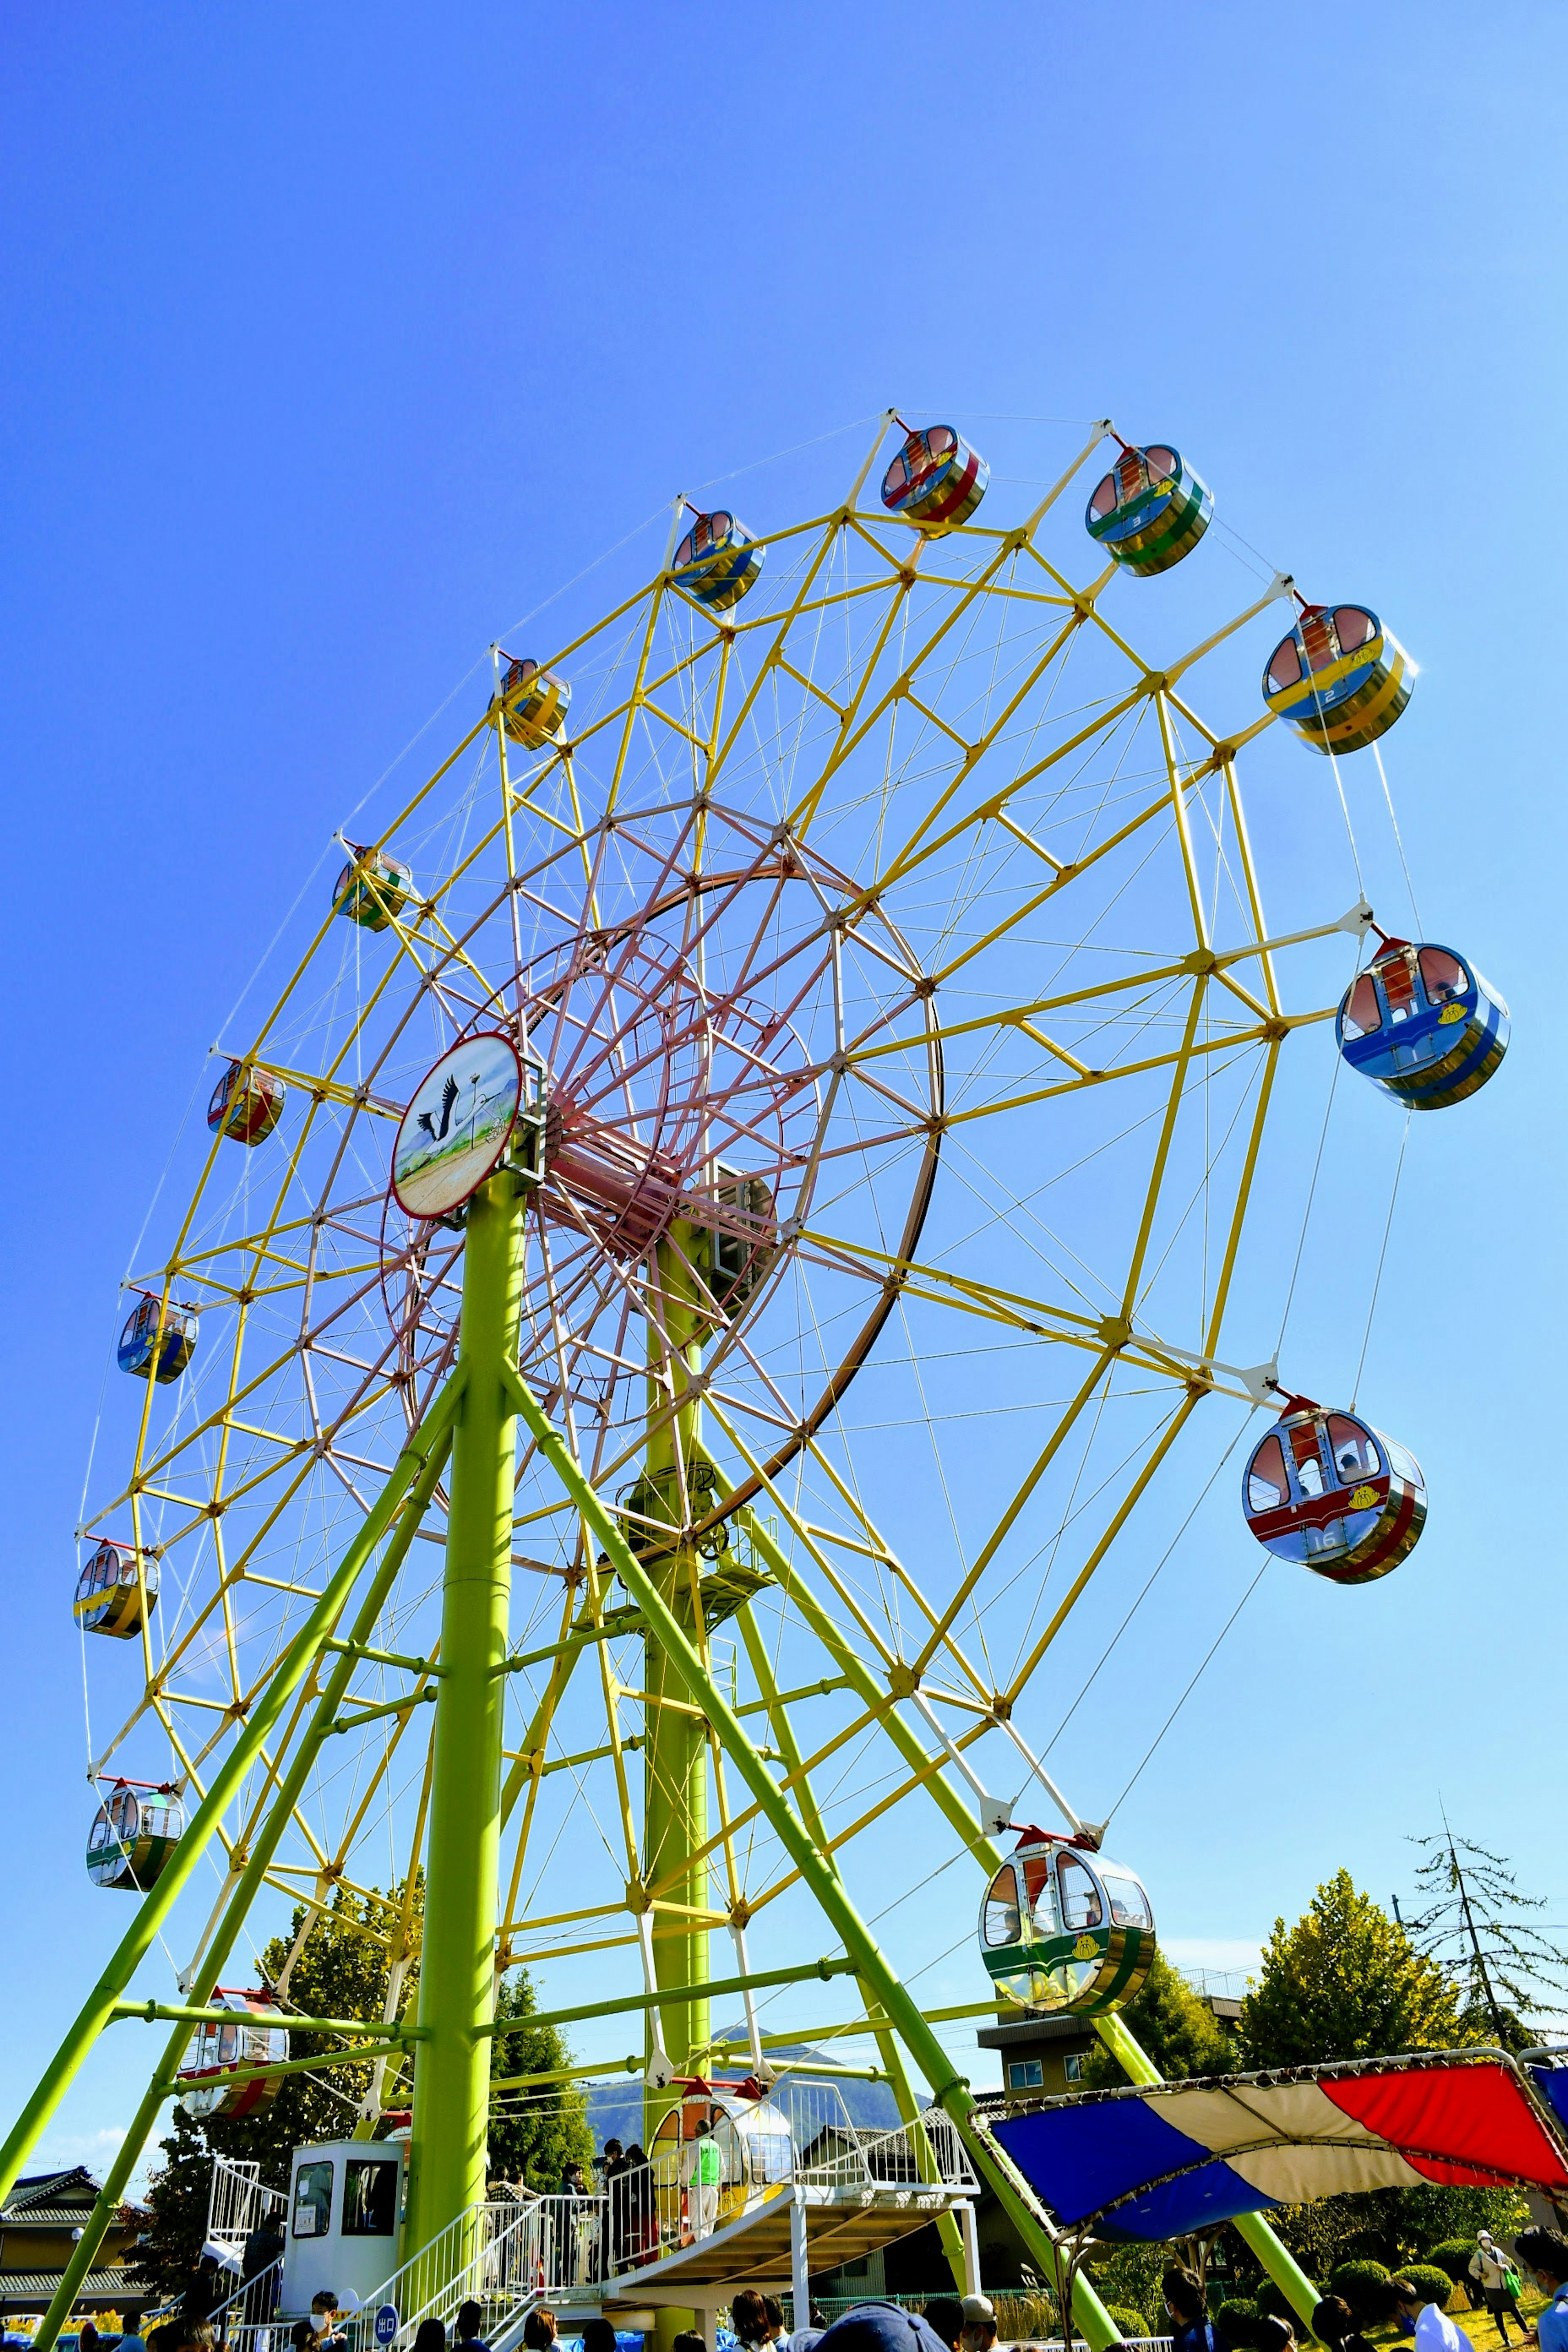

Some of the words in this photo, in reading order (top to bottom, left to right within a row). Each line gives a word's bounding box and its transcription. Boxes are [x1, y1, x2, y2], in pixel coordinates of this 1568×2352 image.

[920, 484, 927, 493] 4
[1133, 516, 1141, 528] 3
[1324, 690, 1336, 702] 2
[1412, 1049, 1417, 1062] 1
[1315, 1532, 1335, 1551] 16
[1040, 1980, 1058, 1997] 15
[378, 2318, 394, 2334] 出口
